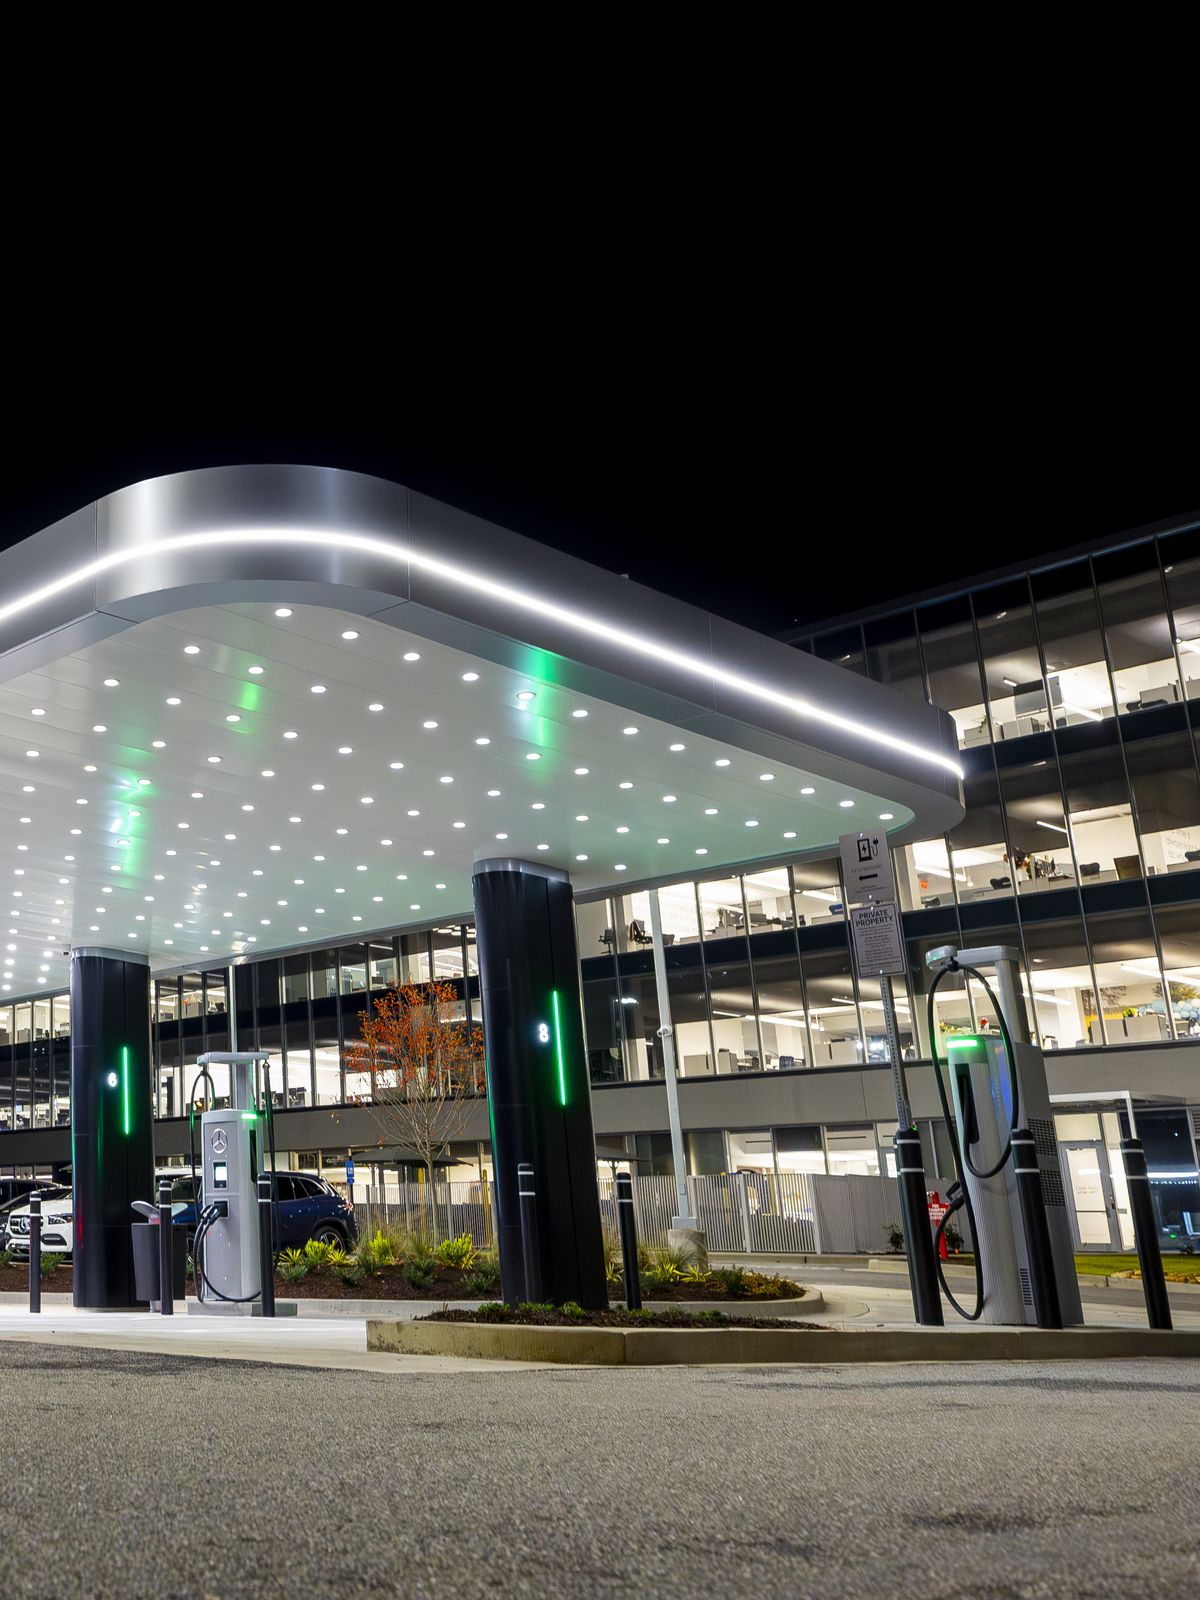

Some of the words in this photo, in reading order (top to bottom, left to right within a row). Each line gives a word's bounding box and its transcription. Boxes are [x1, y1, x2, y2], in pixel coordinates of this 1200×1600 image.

[858, 909, 888, 919] PRIVATE
[855, 915, 893, 927] PROPERTY
[539, 1023, 549, 1042] 8
[108, 1072, 117, 1087] 6
